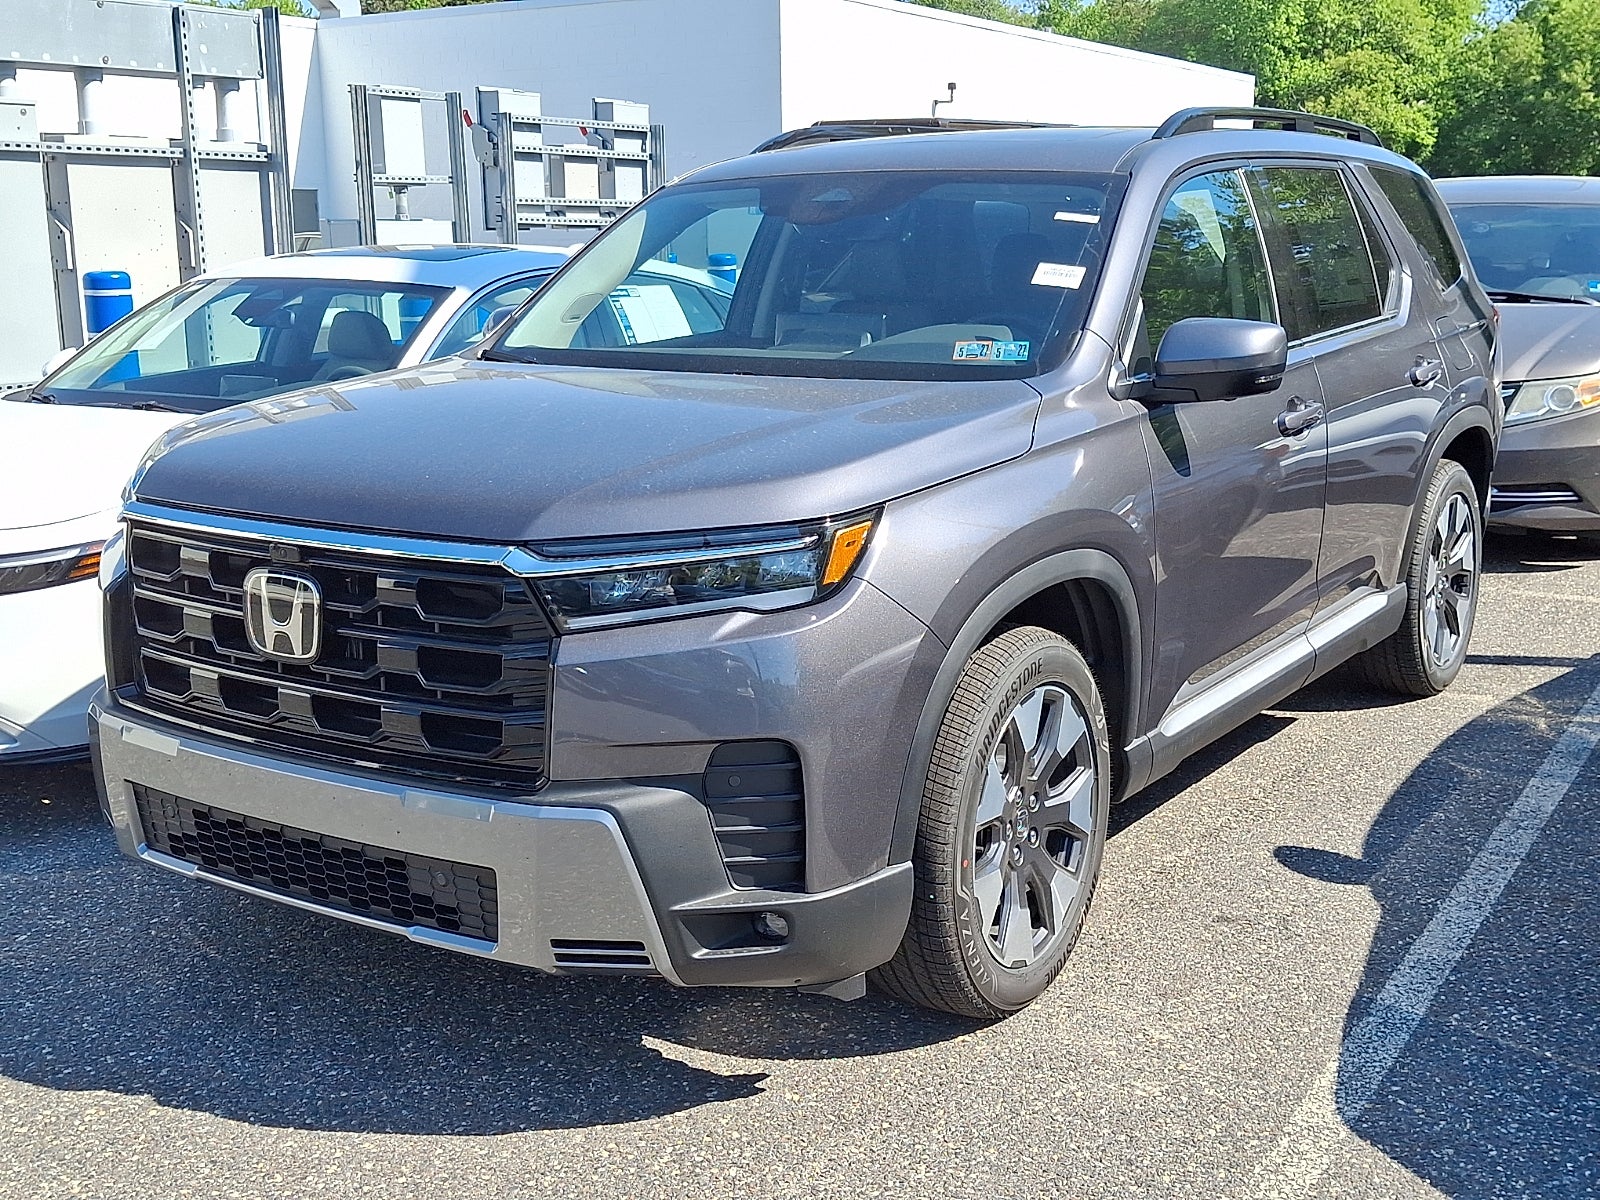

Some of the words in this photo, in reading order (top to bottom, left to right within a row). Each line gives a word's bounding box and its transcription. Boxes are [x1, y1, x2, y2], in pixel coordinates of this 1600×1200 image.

[958, 347, 965, 358] 5
[979, 343, 990, 357] 27
[995, 347, 1002, 358] 5
[974, 656, 1044, 774] BRIDGESTONE
[960, 907, 991, 986] ALENZA
